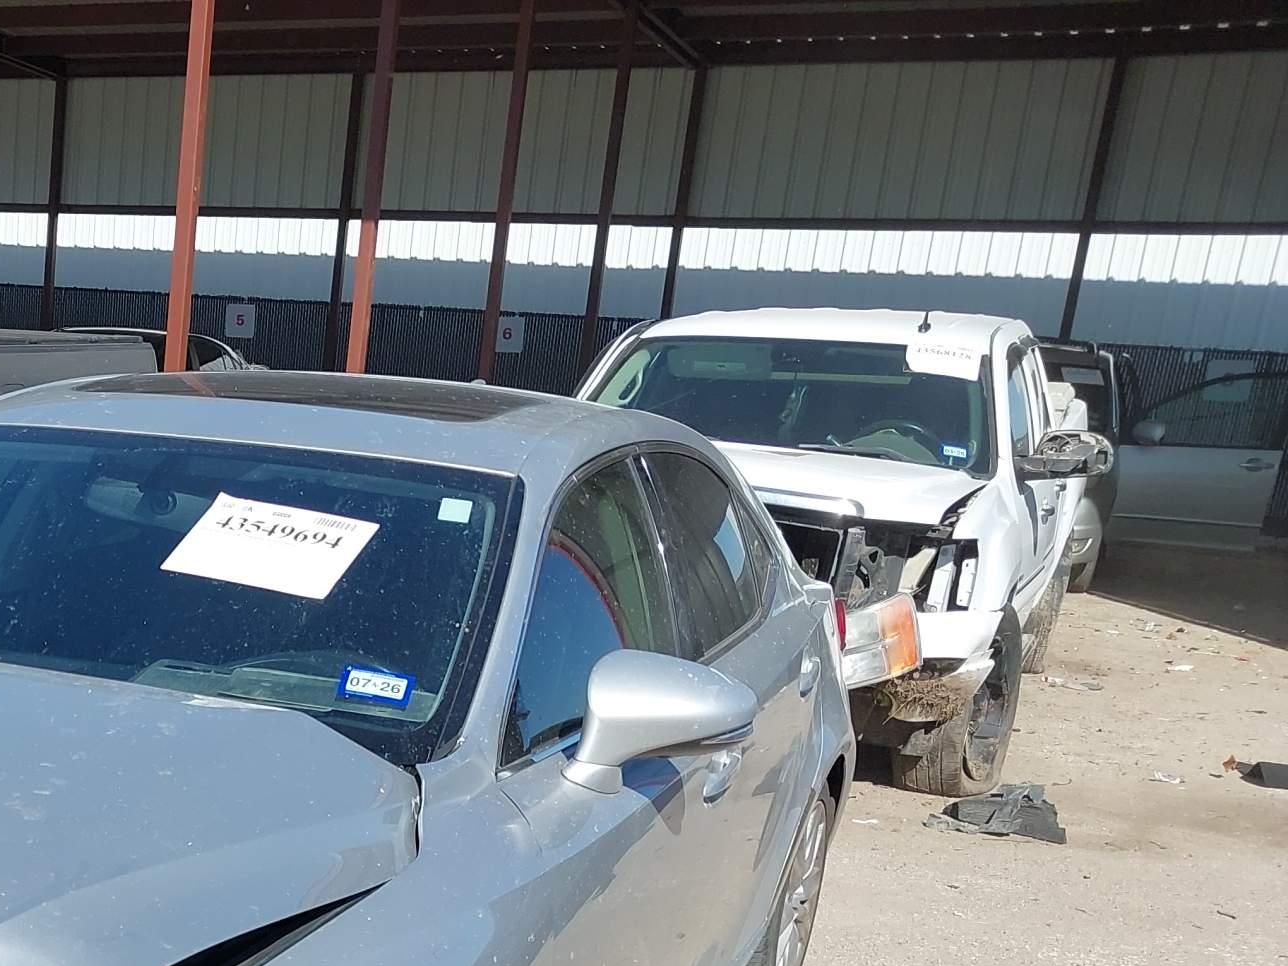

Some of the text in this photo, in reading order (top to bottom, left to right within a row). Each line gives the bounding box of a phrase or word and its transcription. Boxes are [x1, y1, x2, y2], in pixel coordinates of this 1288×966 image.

[236, 314, 245, 326] 5
[502, 327, 513, 340] 6
[215, 515, 344, 549] 43549694
